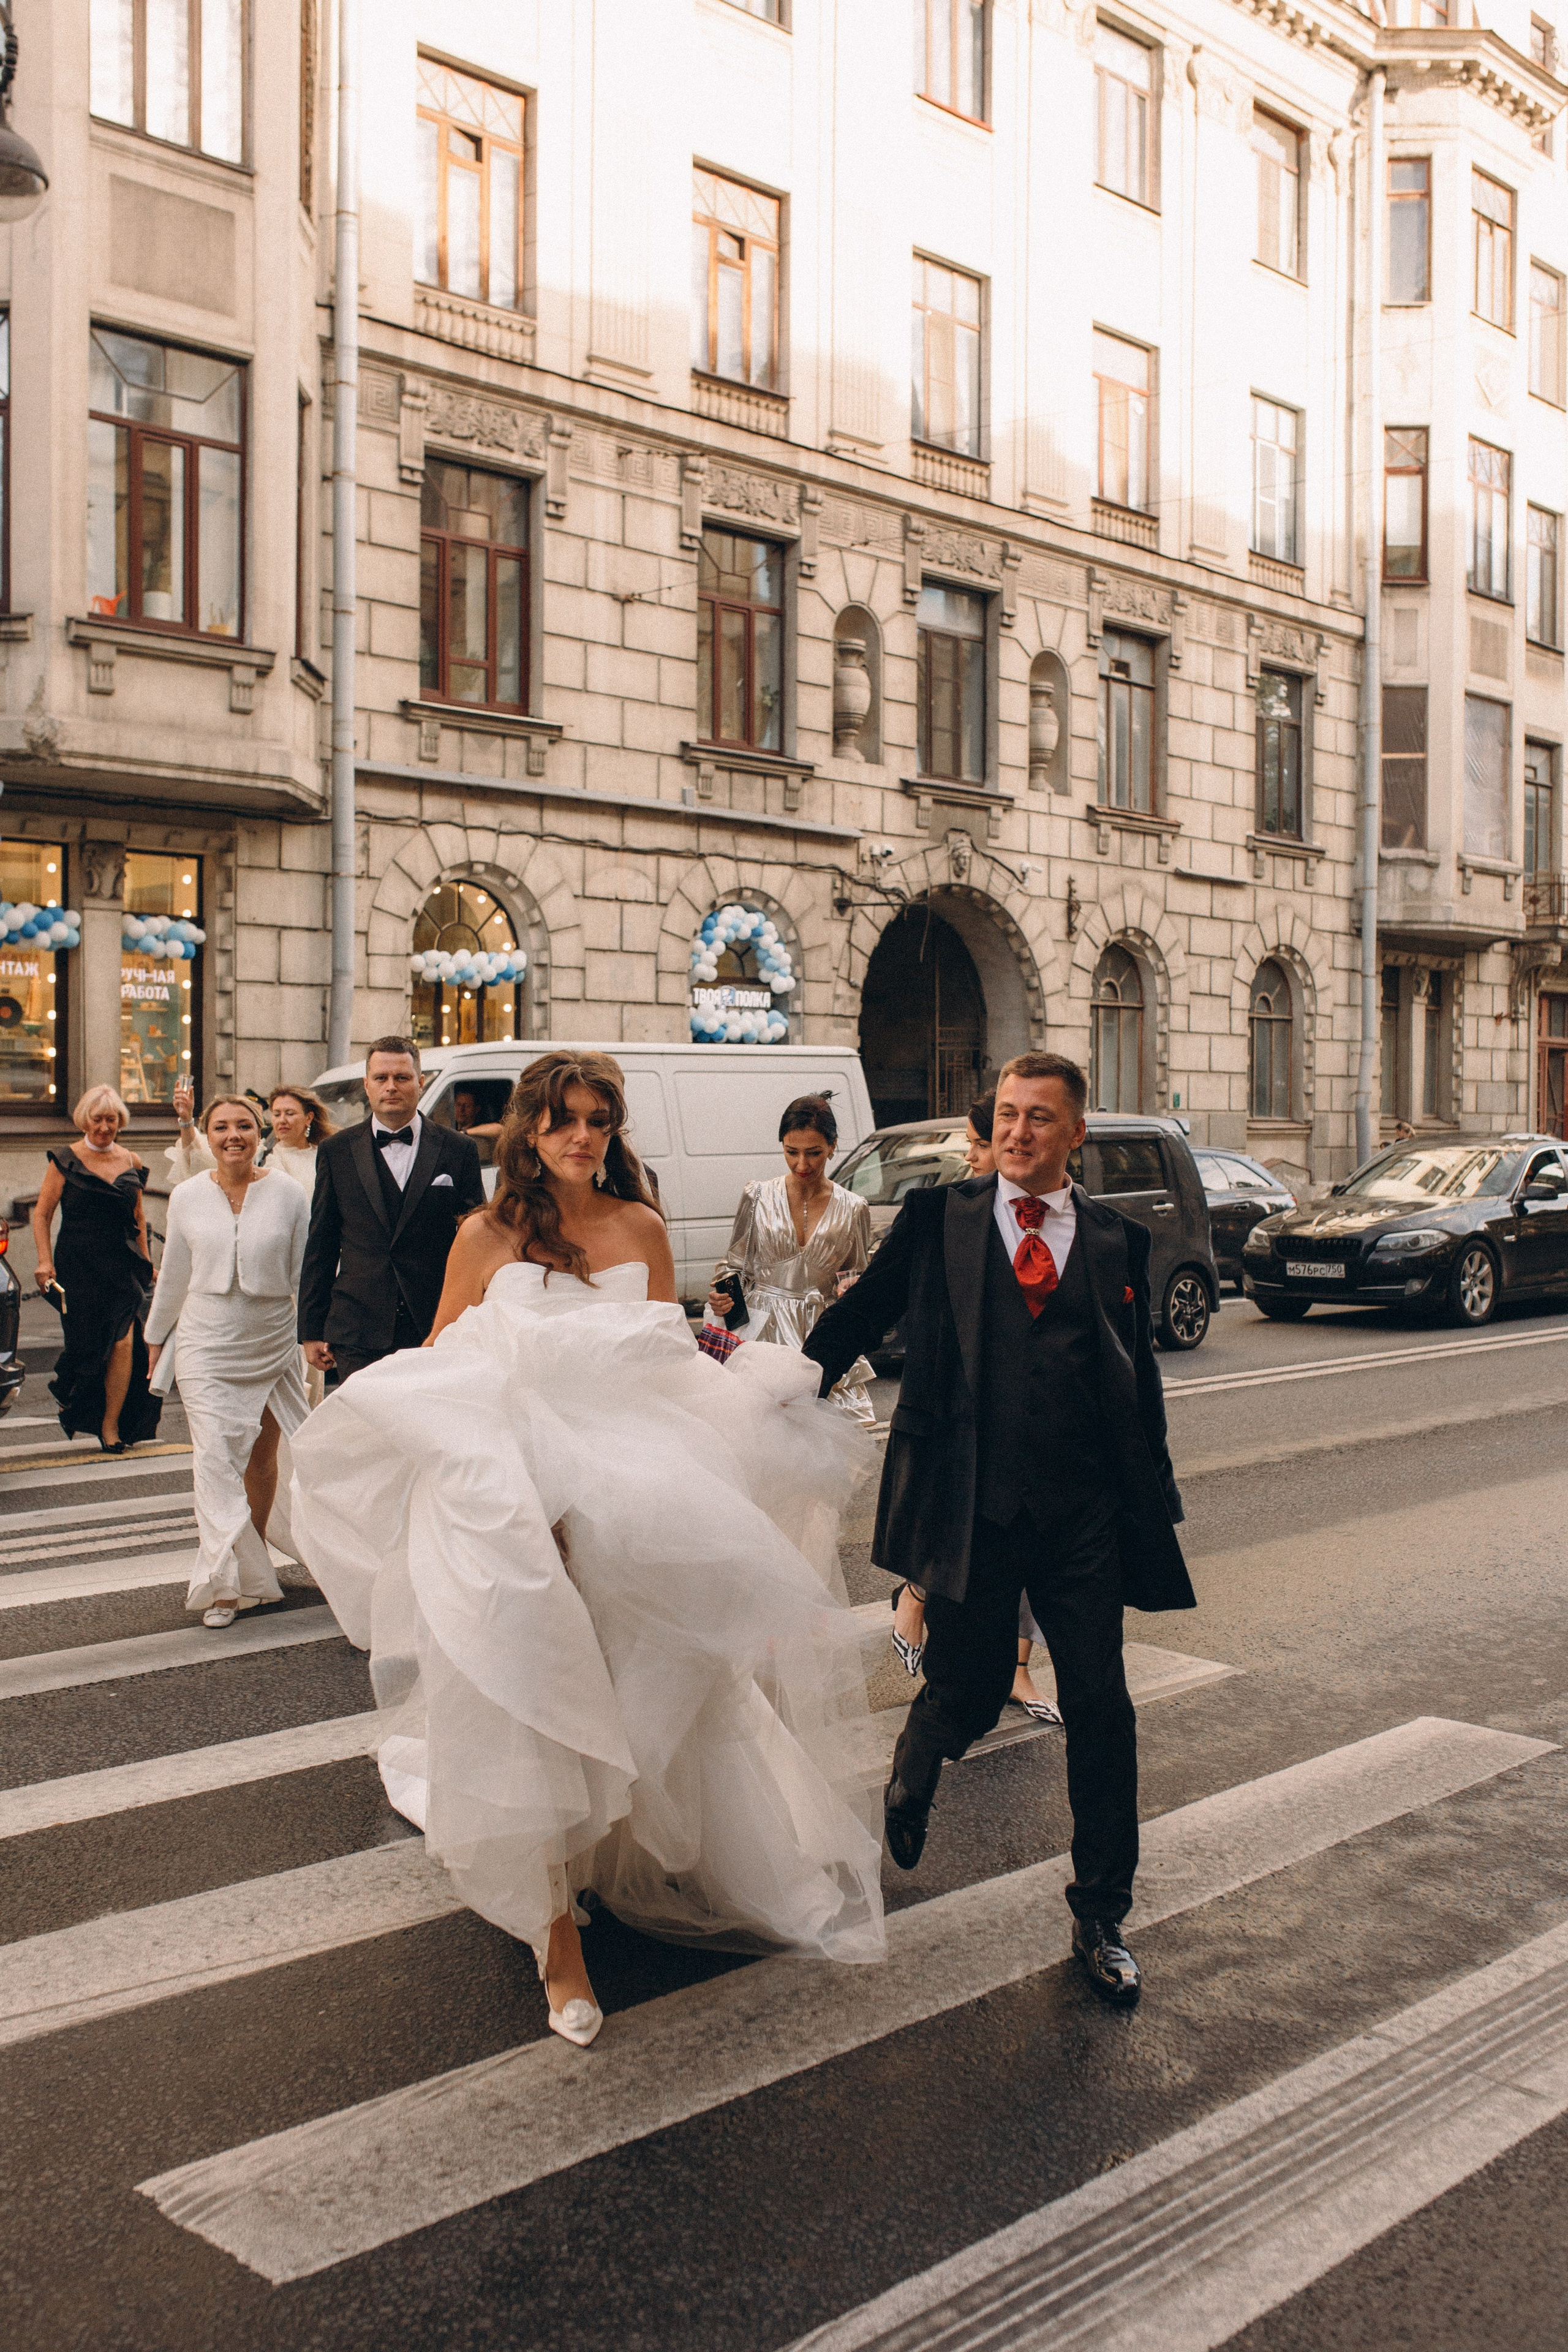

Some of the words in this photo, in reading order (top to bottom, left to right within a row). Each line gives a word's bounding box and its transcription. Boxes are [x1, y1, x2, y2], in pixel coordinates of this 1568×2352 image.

[121, 984, 170, 1001] РАБОТА
[693, 987, 722, 1005] ТВОЯ
[735, 990, 771, 1008] ПОЛКА
